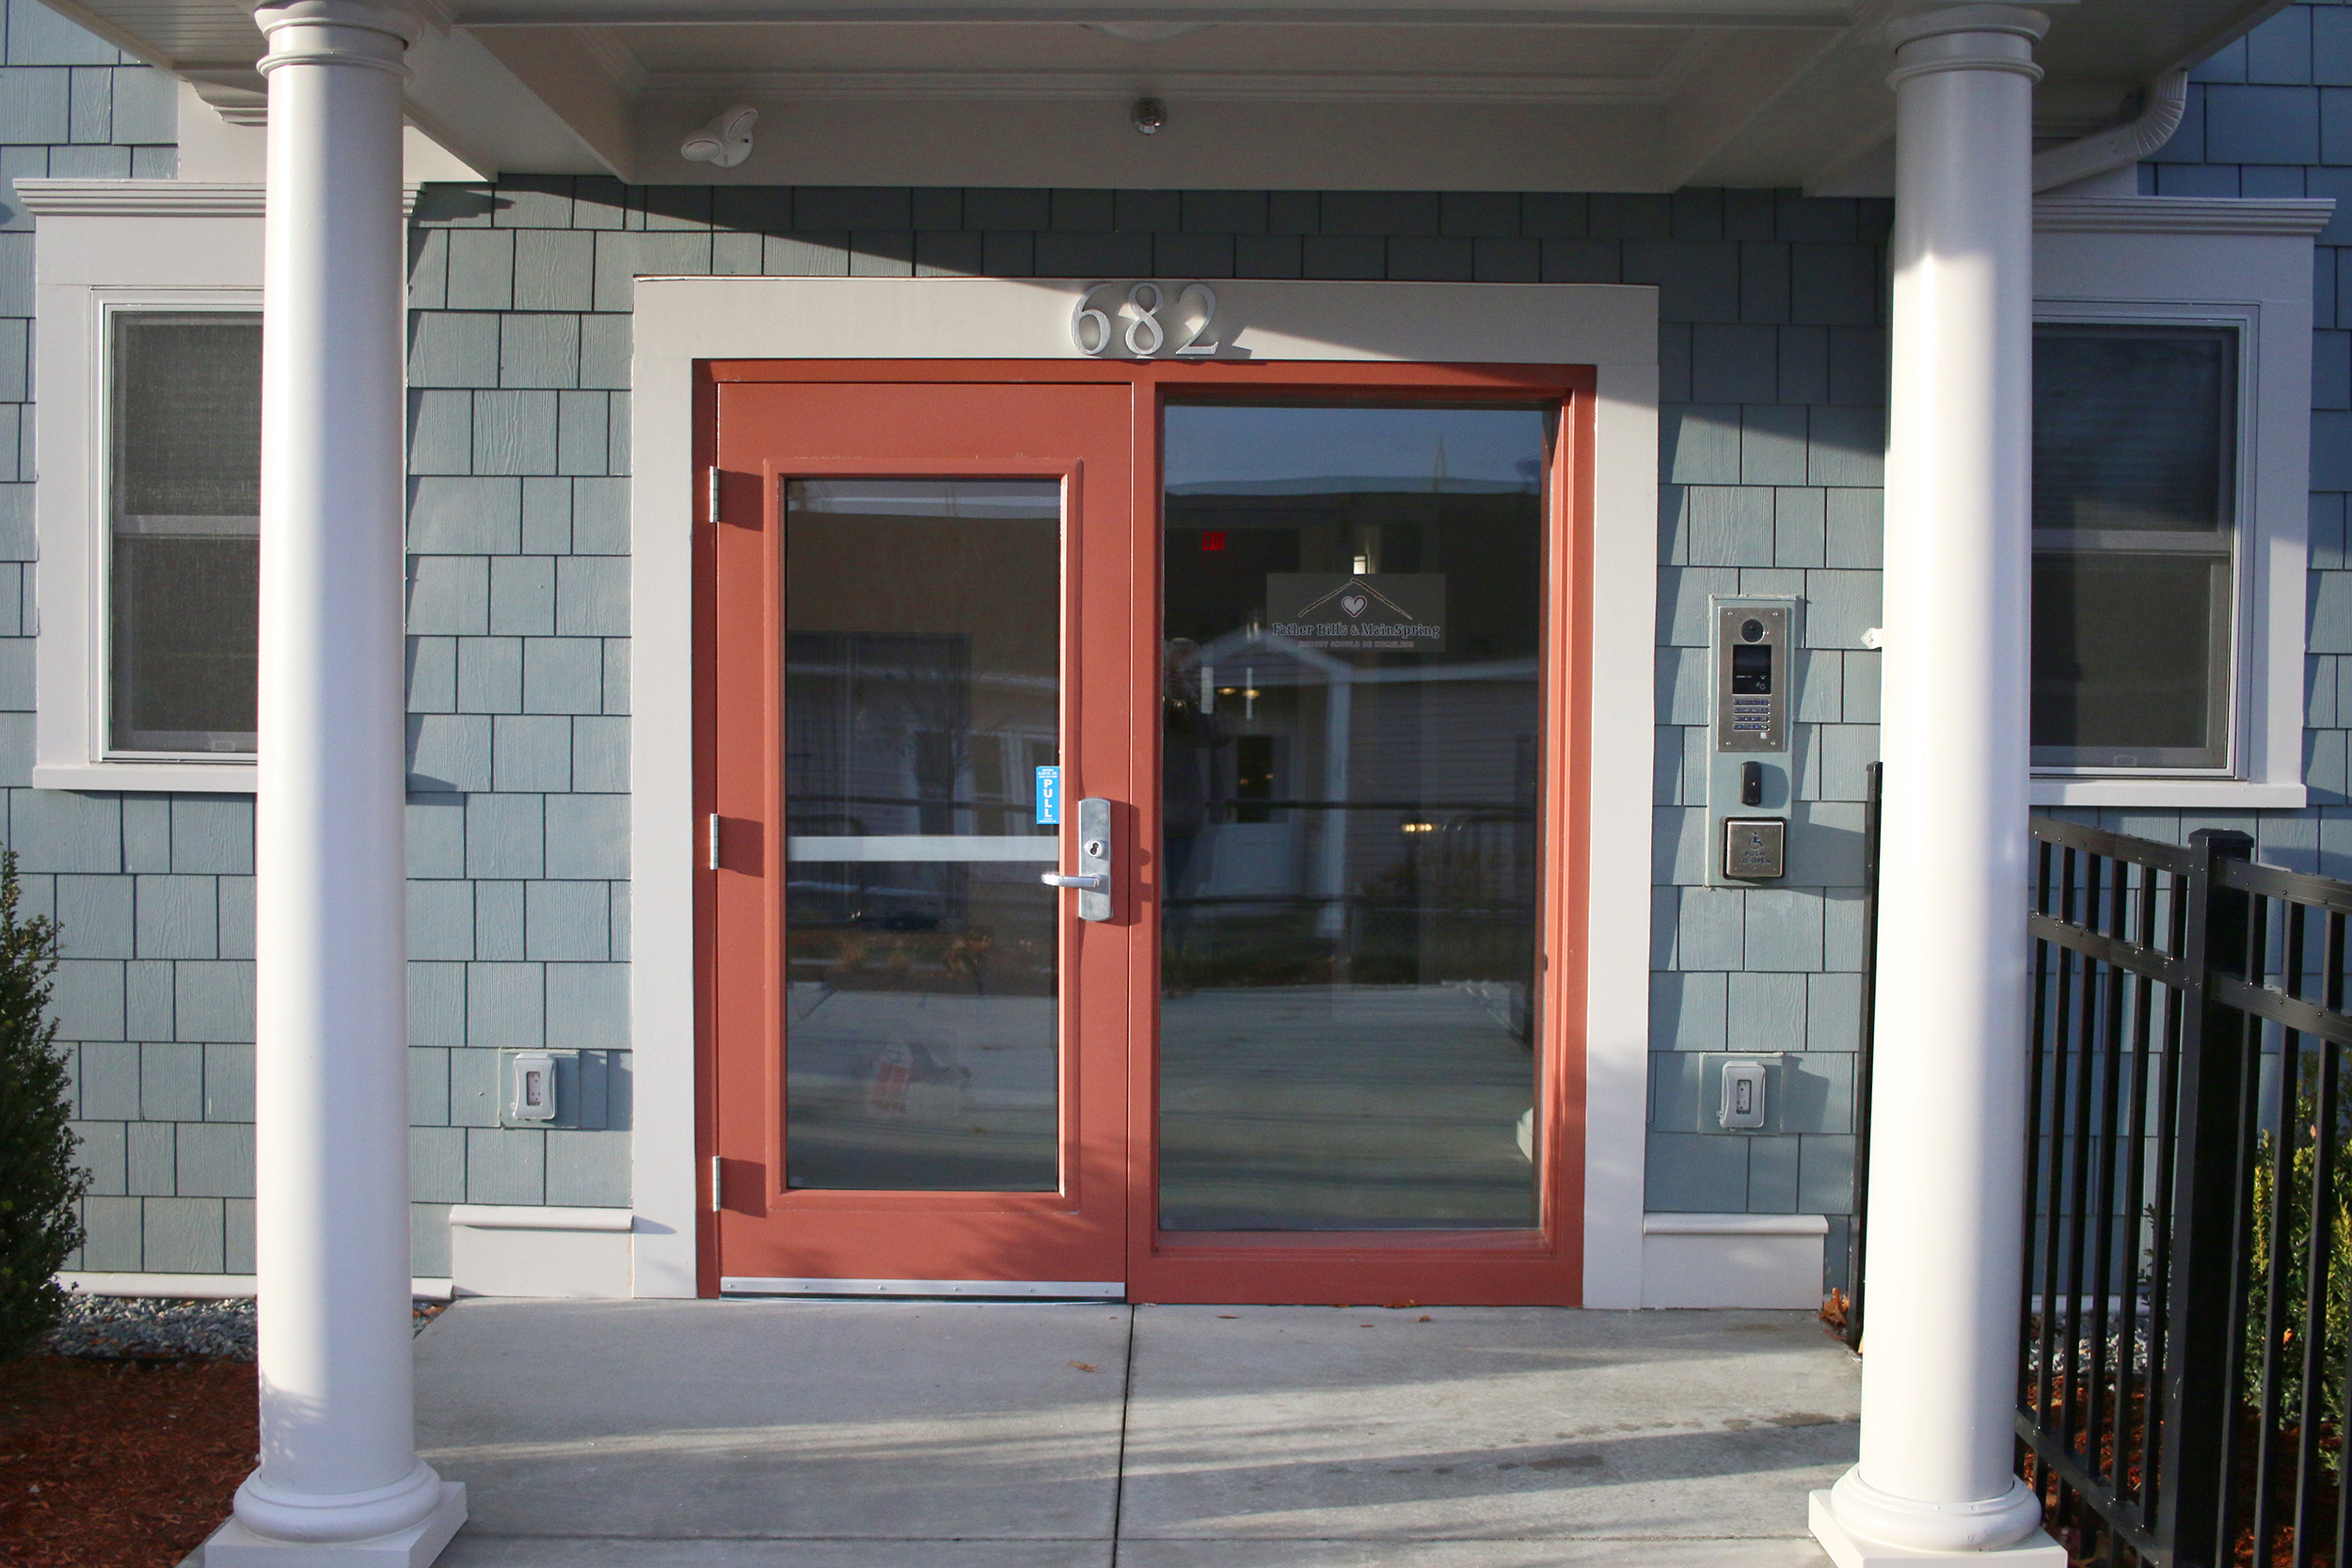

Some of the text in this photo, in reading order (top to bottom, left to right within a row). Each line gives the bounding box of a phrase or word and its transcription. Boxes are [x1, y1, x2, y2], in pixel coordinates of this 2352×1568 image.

[1071, 282, 1219, 356] 682
[1202, 531, 1227, 550] EXIT
[1272, 621, 1440, 639] Father Bill's & MainSpring
[1043, 779, 1053, 817] PULL
